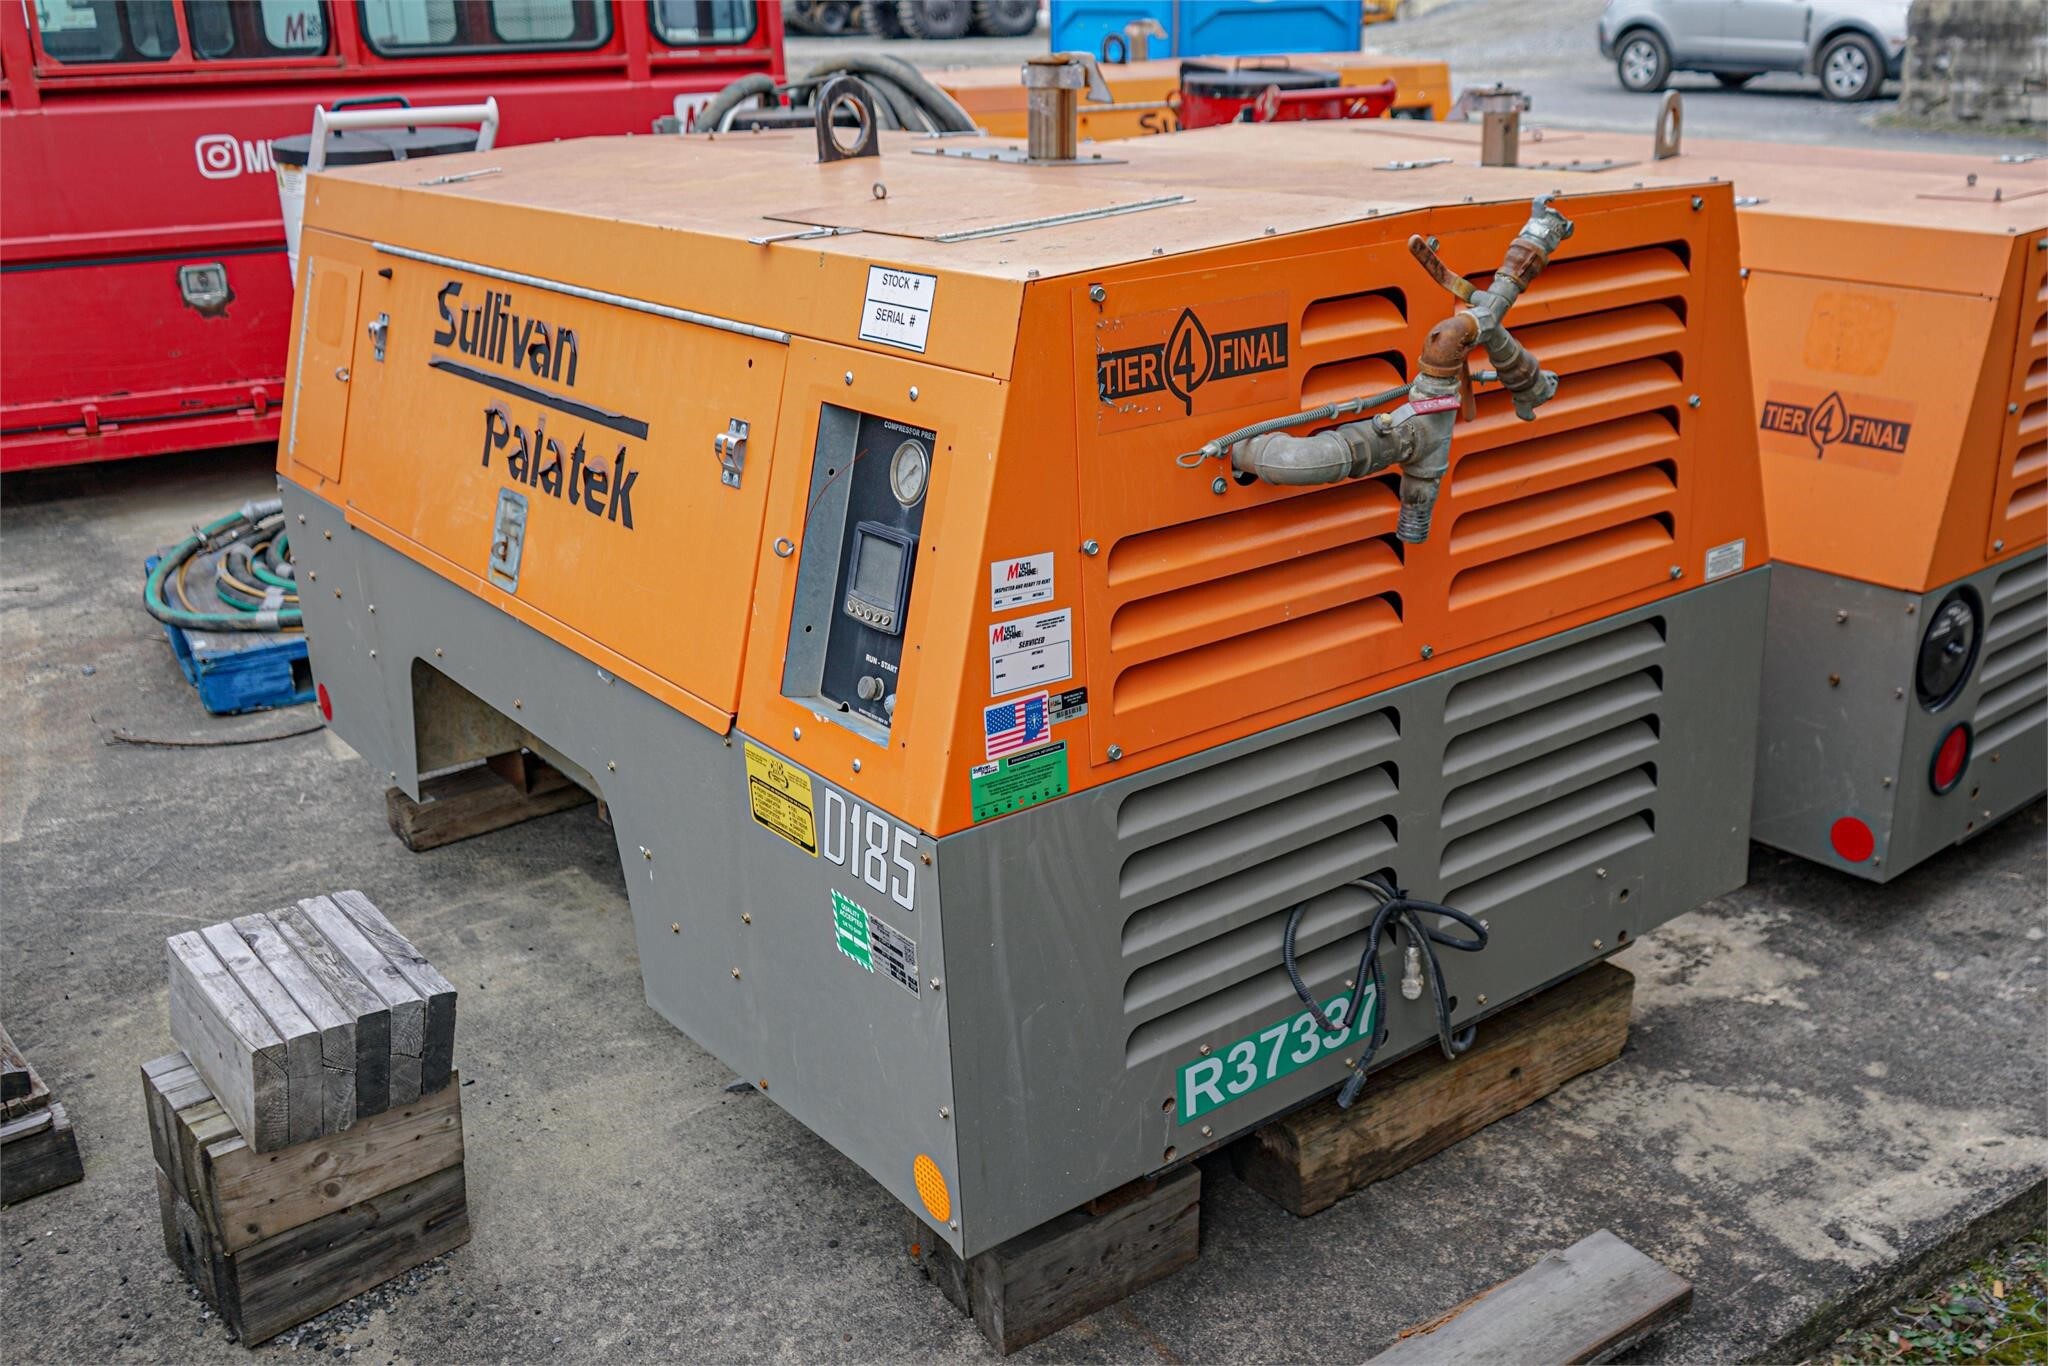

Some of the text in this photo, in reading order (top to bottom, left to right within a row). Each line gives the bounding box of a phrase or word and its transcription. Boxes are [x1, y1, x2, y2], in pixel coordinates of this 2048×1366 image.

[882, 273, 920, 291] STOCK #
[433, 280, 578, 387] Sullivan
[875, 307, 916, 328] SERIAL #
[1101, 353, 1159, 394] TIER
[1220, 331, 1286, 374] FINAL
[1765, 405, 1806, 433] TIER
[1850, 419, 1905, 450] FINAL
[482, 404, 639, 531] Palatek
[865, 653, 877, 664] RUN
[880, 660, 898, 673] START
[1018, 636, 1045, 648] SERVICED
[824, 787, 918, 911] D185
[1184, 983, 1377, 1118] R37337
